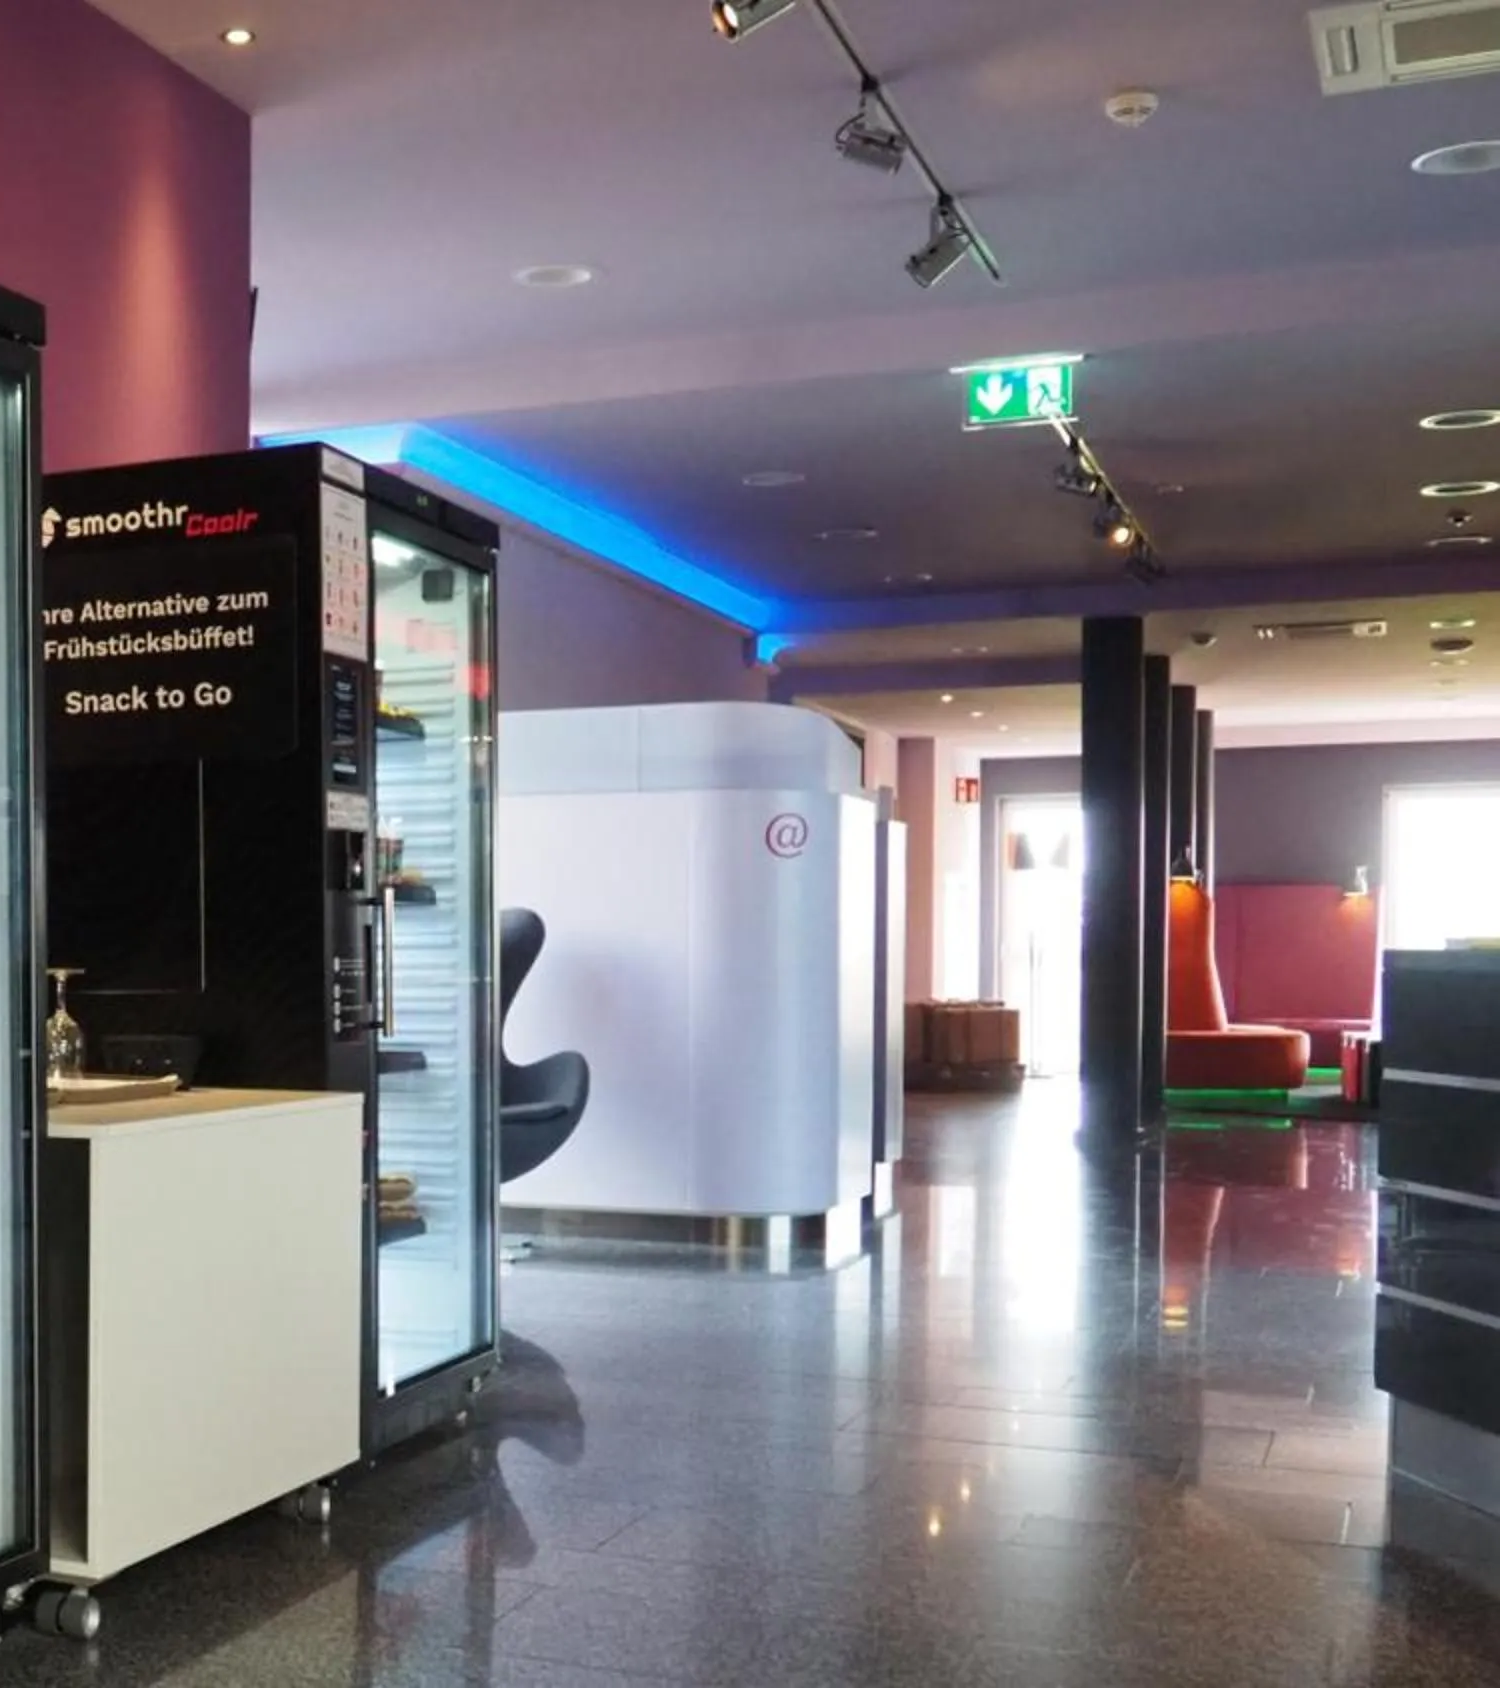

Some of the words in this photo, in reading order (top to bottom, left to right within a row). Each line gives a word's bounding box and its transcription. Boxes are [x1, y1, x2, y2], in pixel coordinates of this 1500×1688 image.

[65, 500, 189, 538] smoothr
[185, 508, 258, 538] Coolr
[80, 592, 209, 623] Alternative
[216, 591, 269, 612] zum
[43, 625, 255, 661] Frühstücksbüffet!
[65, 685, 148, 715] Snack
[155, 685, 185, 709] to
[194, 682, 233, 707] Go
